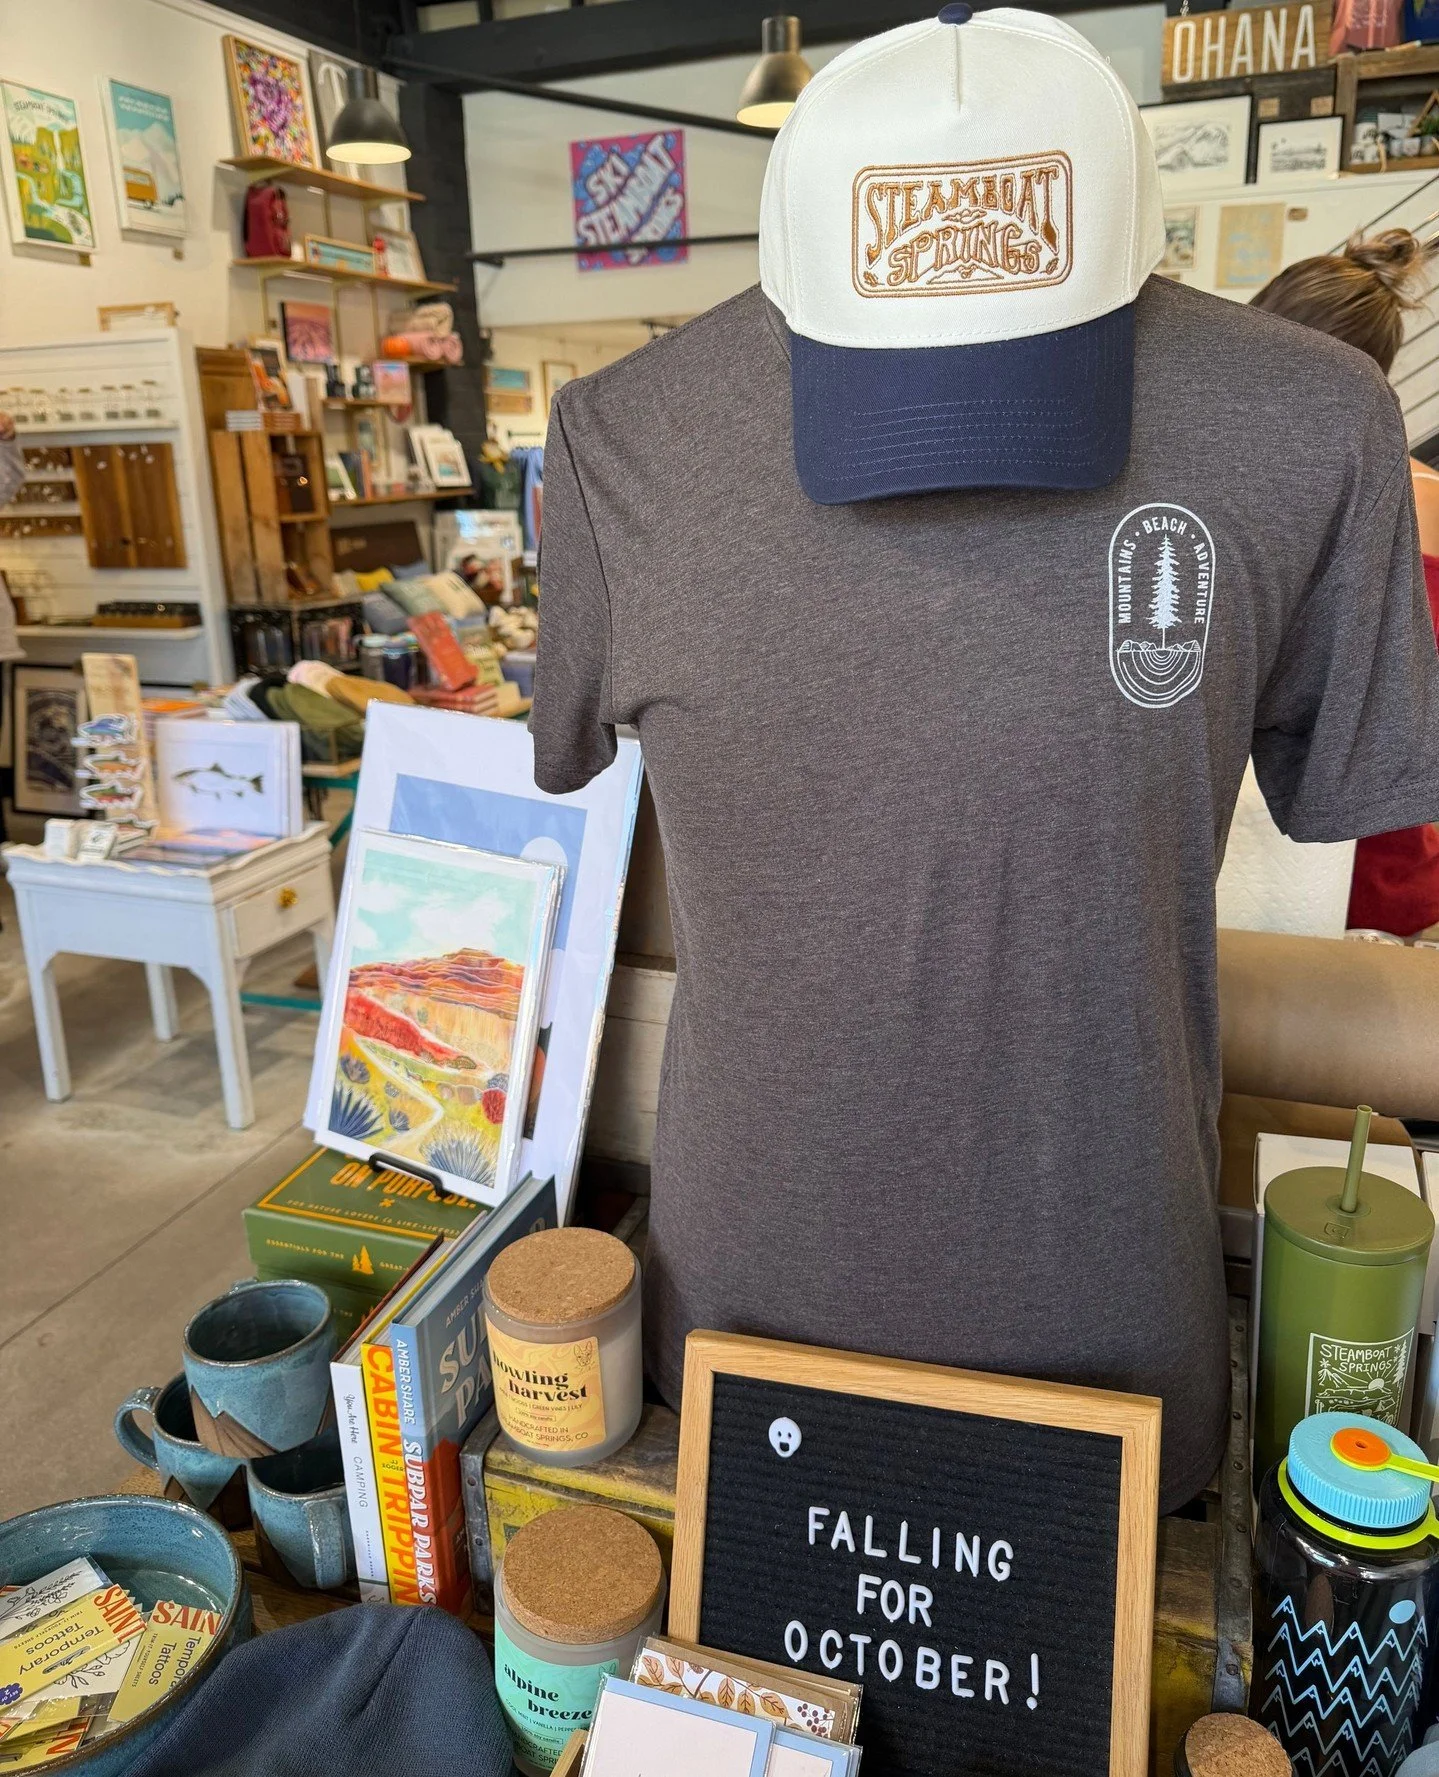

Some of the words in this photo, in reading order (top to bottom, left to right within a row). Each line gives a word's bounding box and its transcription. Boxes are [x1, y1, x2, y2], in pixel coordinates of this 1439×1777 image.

[1172, 5, 1317, 83] OHANA
[587, 153, 630, 207] SKI
[865, 165, 1060, 269] STEAMBOAT
[887, 219, 1042, 286] SPRINGS
[1118, 539, 1138, 625] MOUNTAINS
[1142, 516, 1188, 536] BEACH
[1193, 542, 1210, 625] ADVENTURE
[330, 1162, 374, 1189] ON
[397, 1338, 413, 1383] AMBER
[1320, 1344, 1393, 1363] STEAMBOAT
[1339, 1359, 1393, 1373] SPRINGS
[367, 1346, 403, 1457] CABIN
[401, 1383, 416, 1426] SHARE
[508, 1379, 587, 1402] harvest
[574, 1431, 590, 1441] CO
[353, 1456, 368, 1508] CAMPING
[403, 1438, 429, 1529] SUBPAR
[382, 1477, 421, 1604] TRIPPIN
[808, 1506, 1015, 1582] FALLING
[413, 1531, 438, 1605] PARKS
[93, 1586, 148, 1645] SAINT
[152, 1601, 223, 1636] SAIN
[857, 1573, 934, 1627] FOR
[20, 1626, 104, 1675] Temporary
[26, 1622, 84, 1655] Tattoos
[169, 1636, 202, 1690] Tempora
[149, 1642, 177, 1686] Tattoos
[504, 1664, 560, 1702] alpine
[528, 1699, 593, 1720] breeze
[533, 1720, 554, 1730] VANILLA
